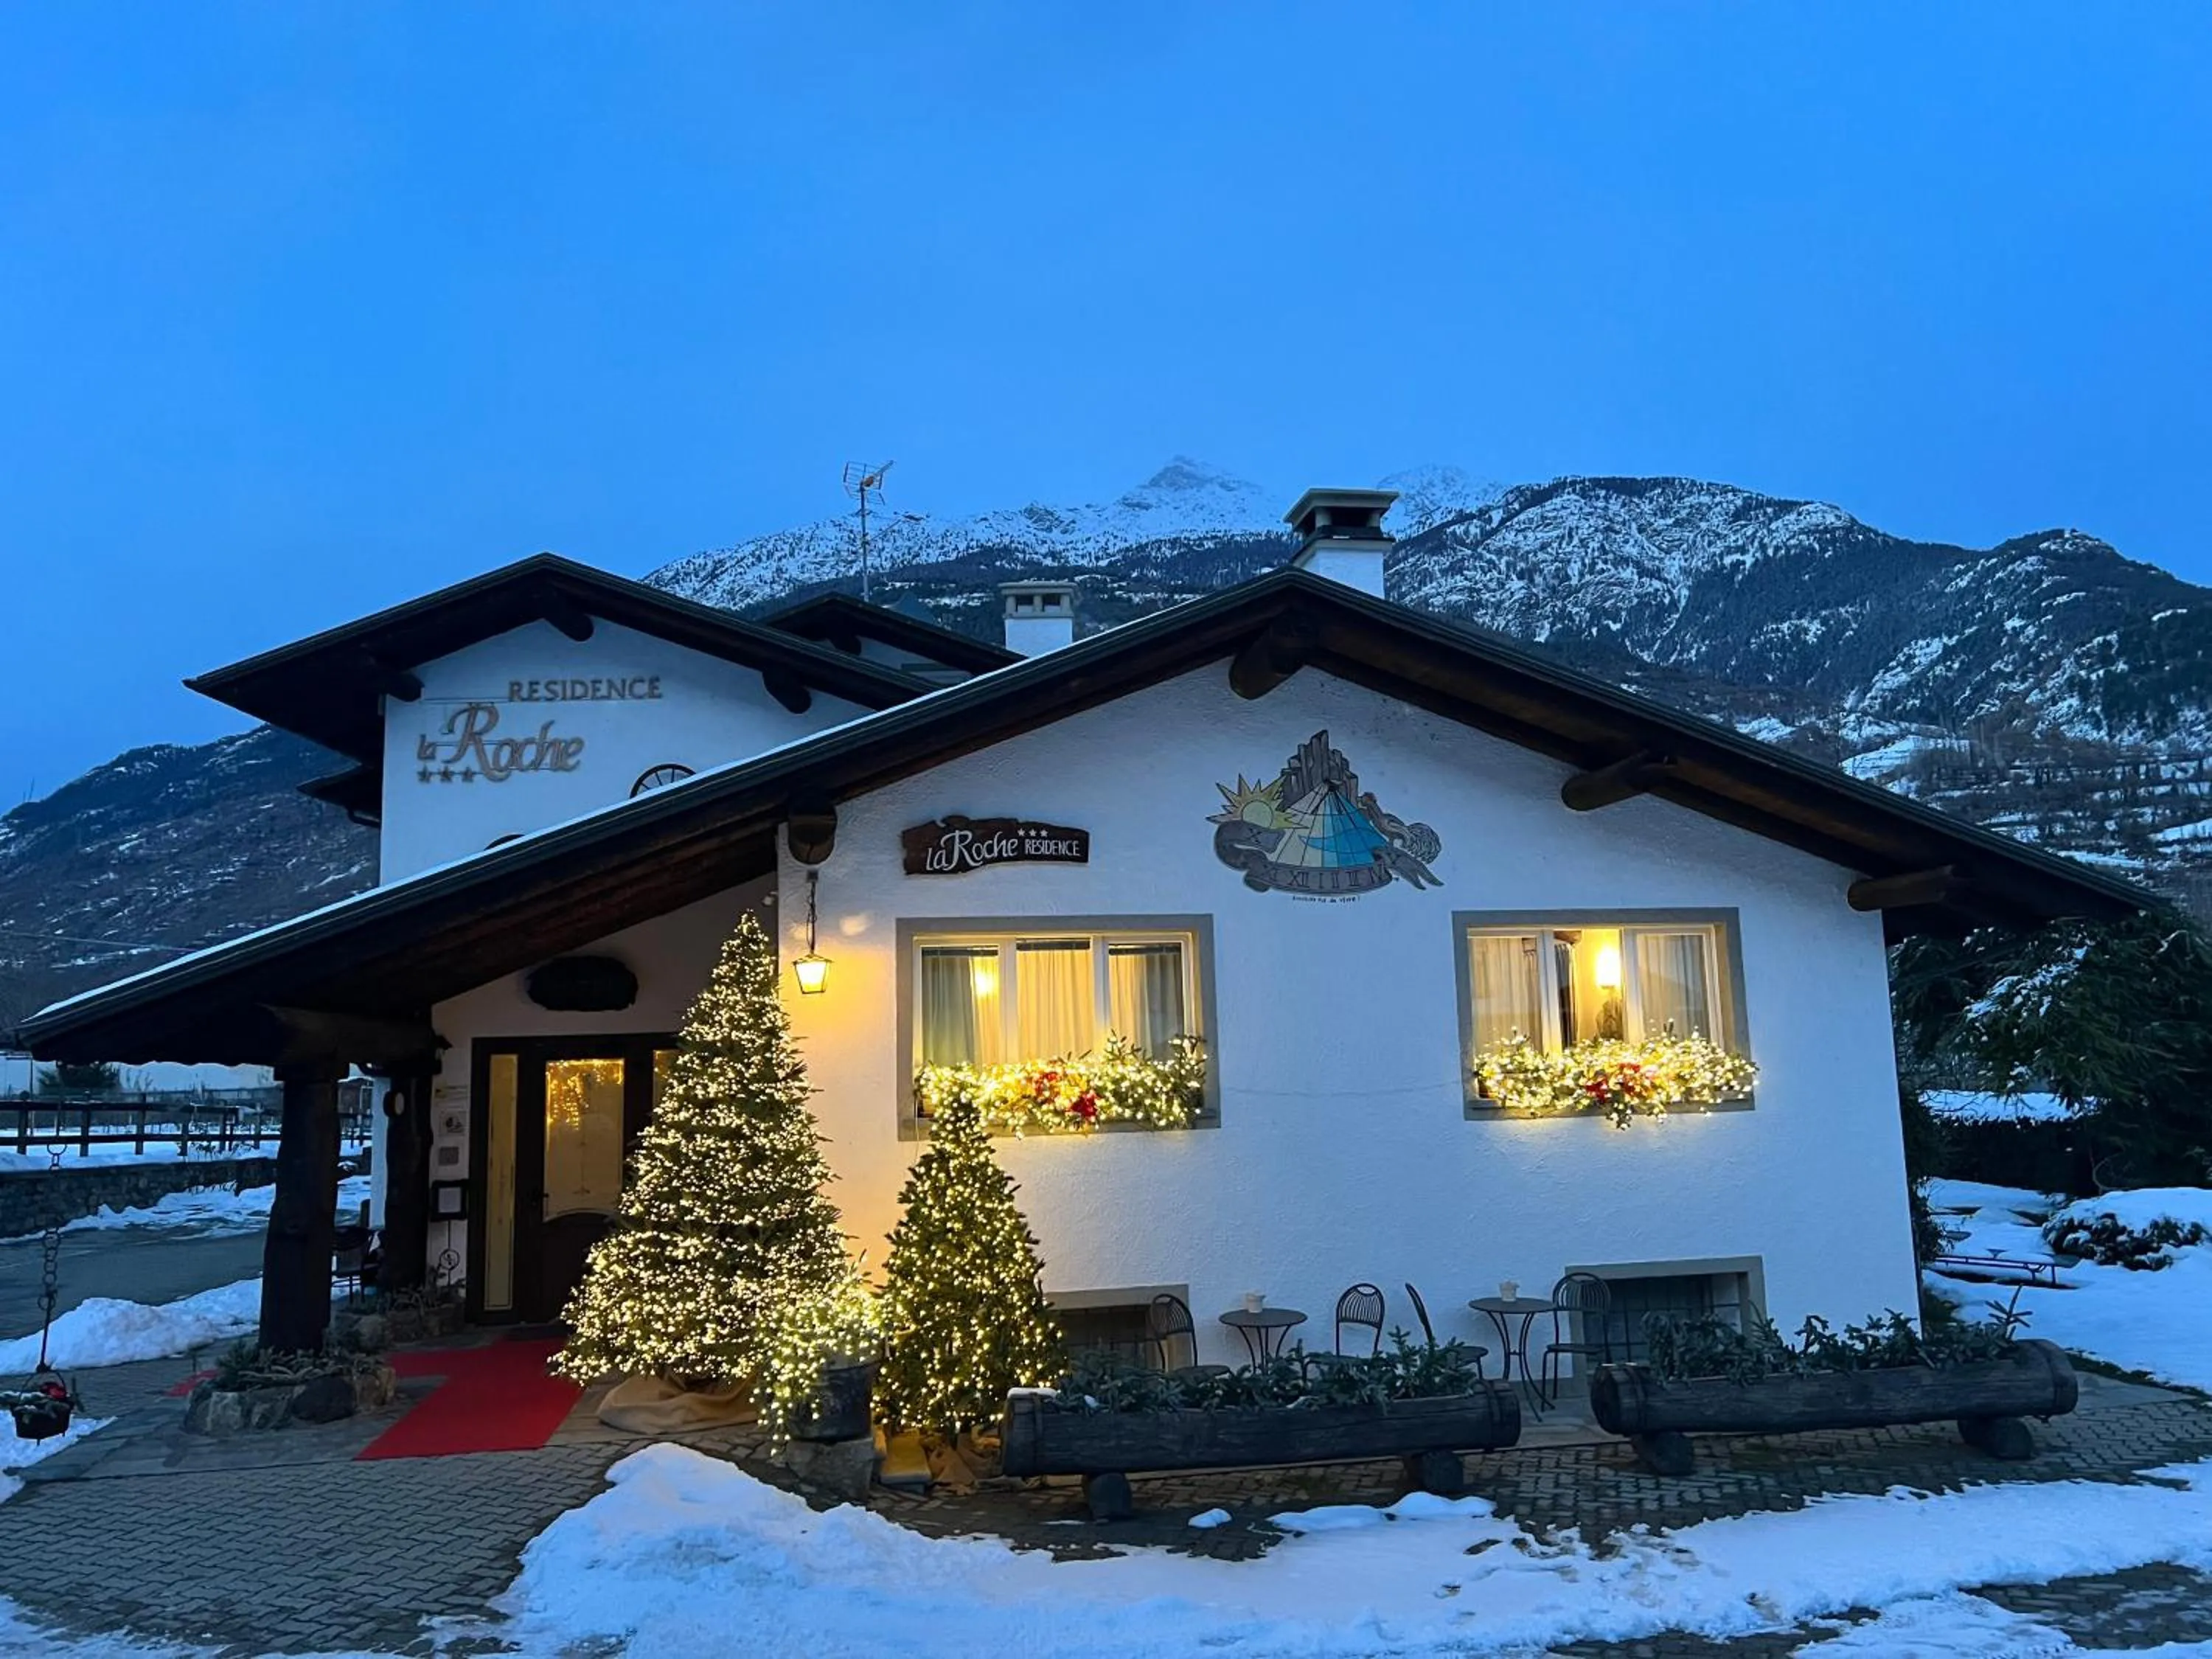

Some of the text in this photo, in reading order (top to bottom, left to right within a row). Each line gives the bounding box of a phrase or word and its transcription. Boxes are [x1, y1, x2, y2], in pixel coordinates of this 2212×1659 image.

[508, 675, 663, 703] RESIDENCE
[440, 700, 585, 782] Roche
[926, 830, 1081, 871] la Roche RESIDENCE
